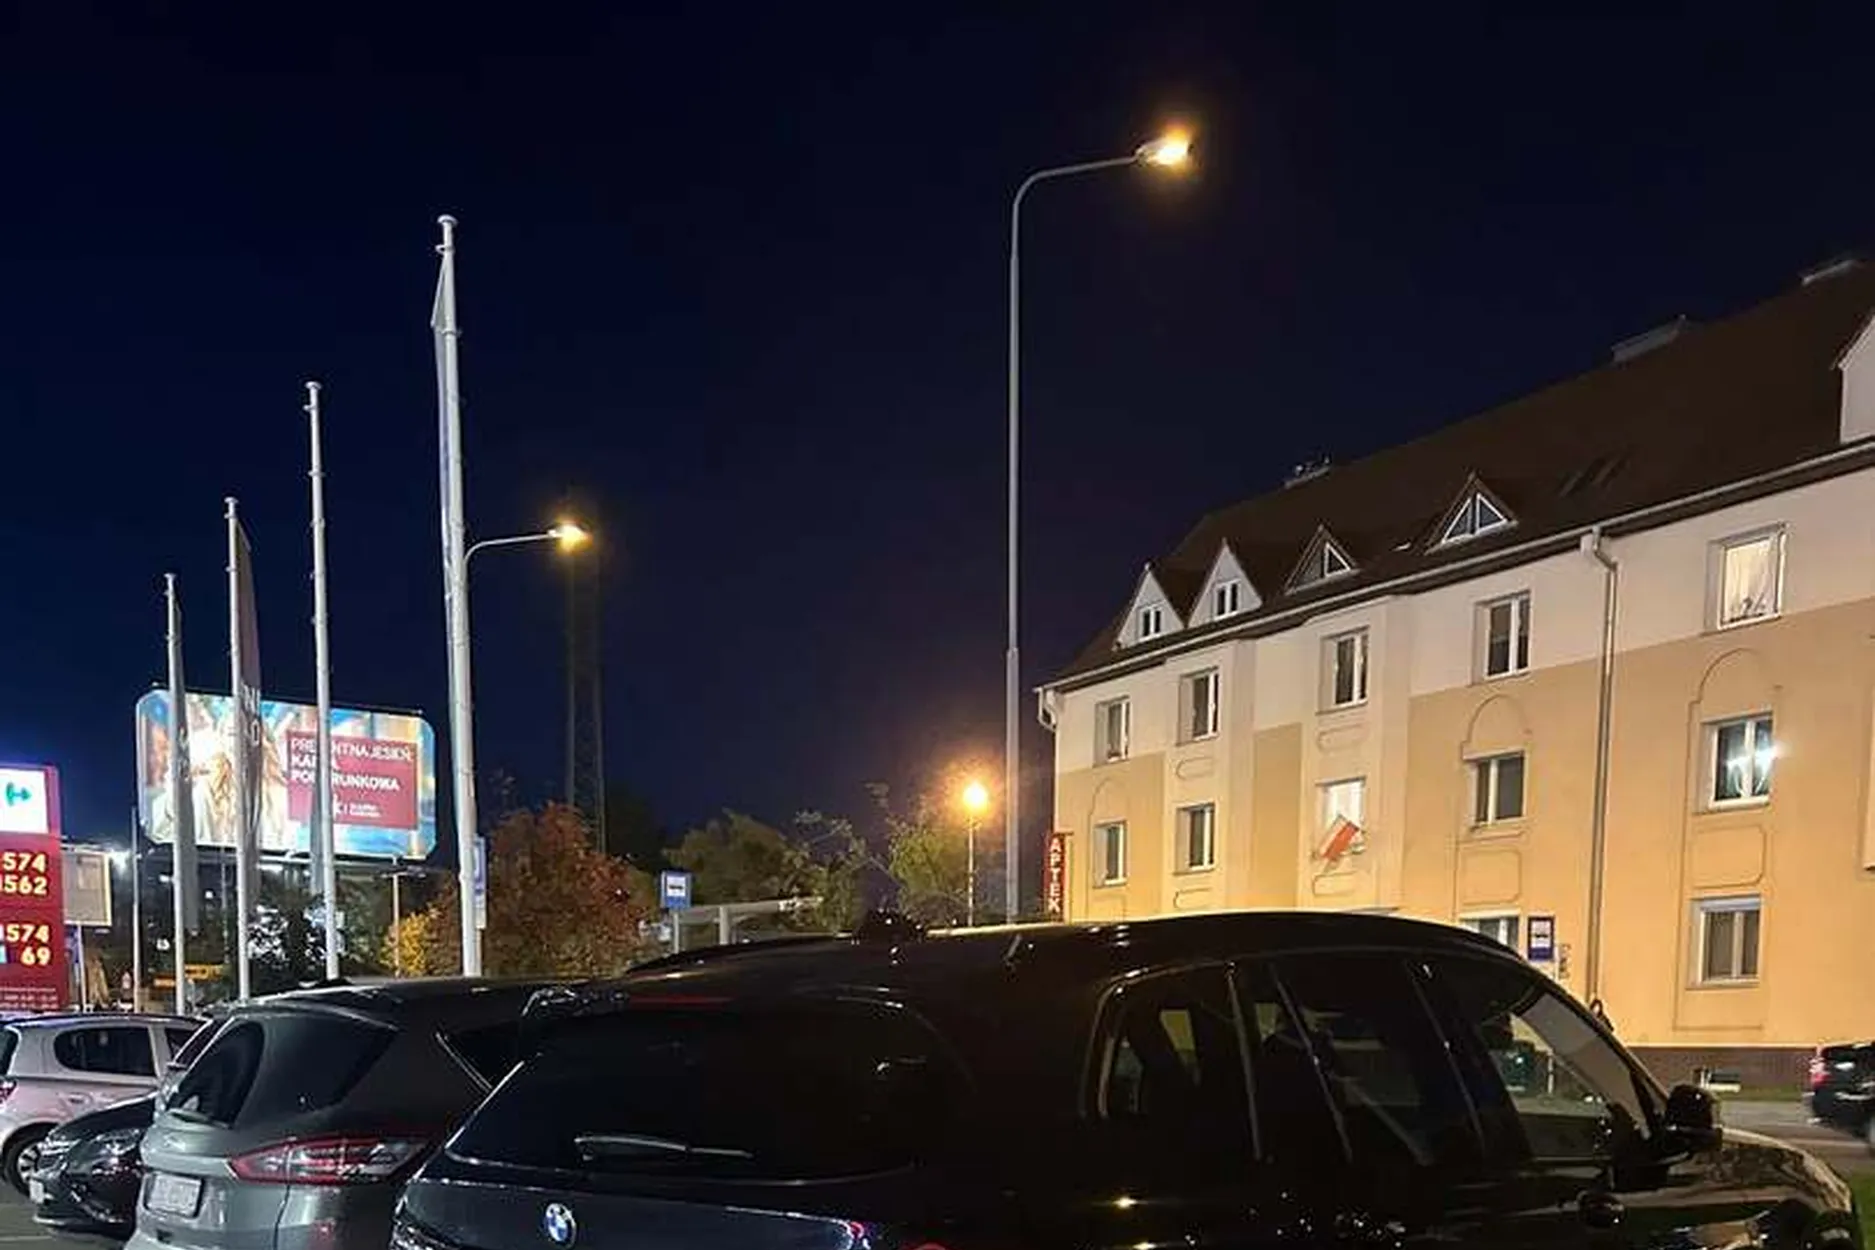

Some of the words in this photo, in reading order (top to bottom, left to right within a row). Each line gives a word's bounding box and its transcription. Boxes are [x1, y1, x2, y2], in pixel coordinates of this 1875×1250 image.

[291, 769, 400, 791] PORUNKOWA
[6, 924, 50, 943] 574
[20, 946, 51, 966] 69
